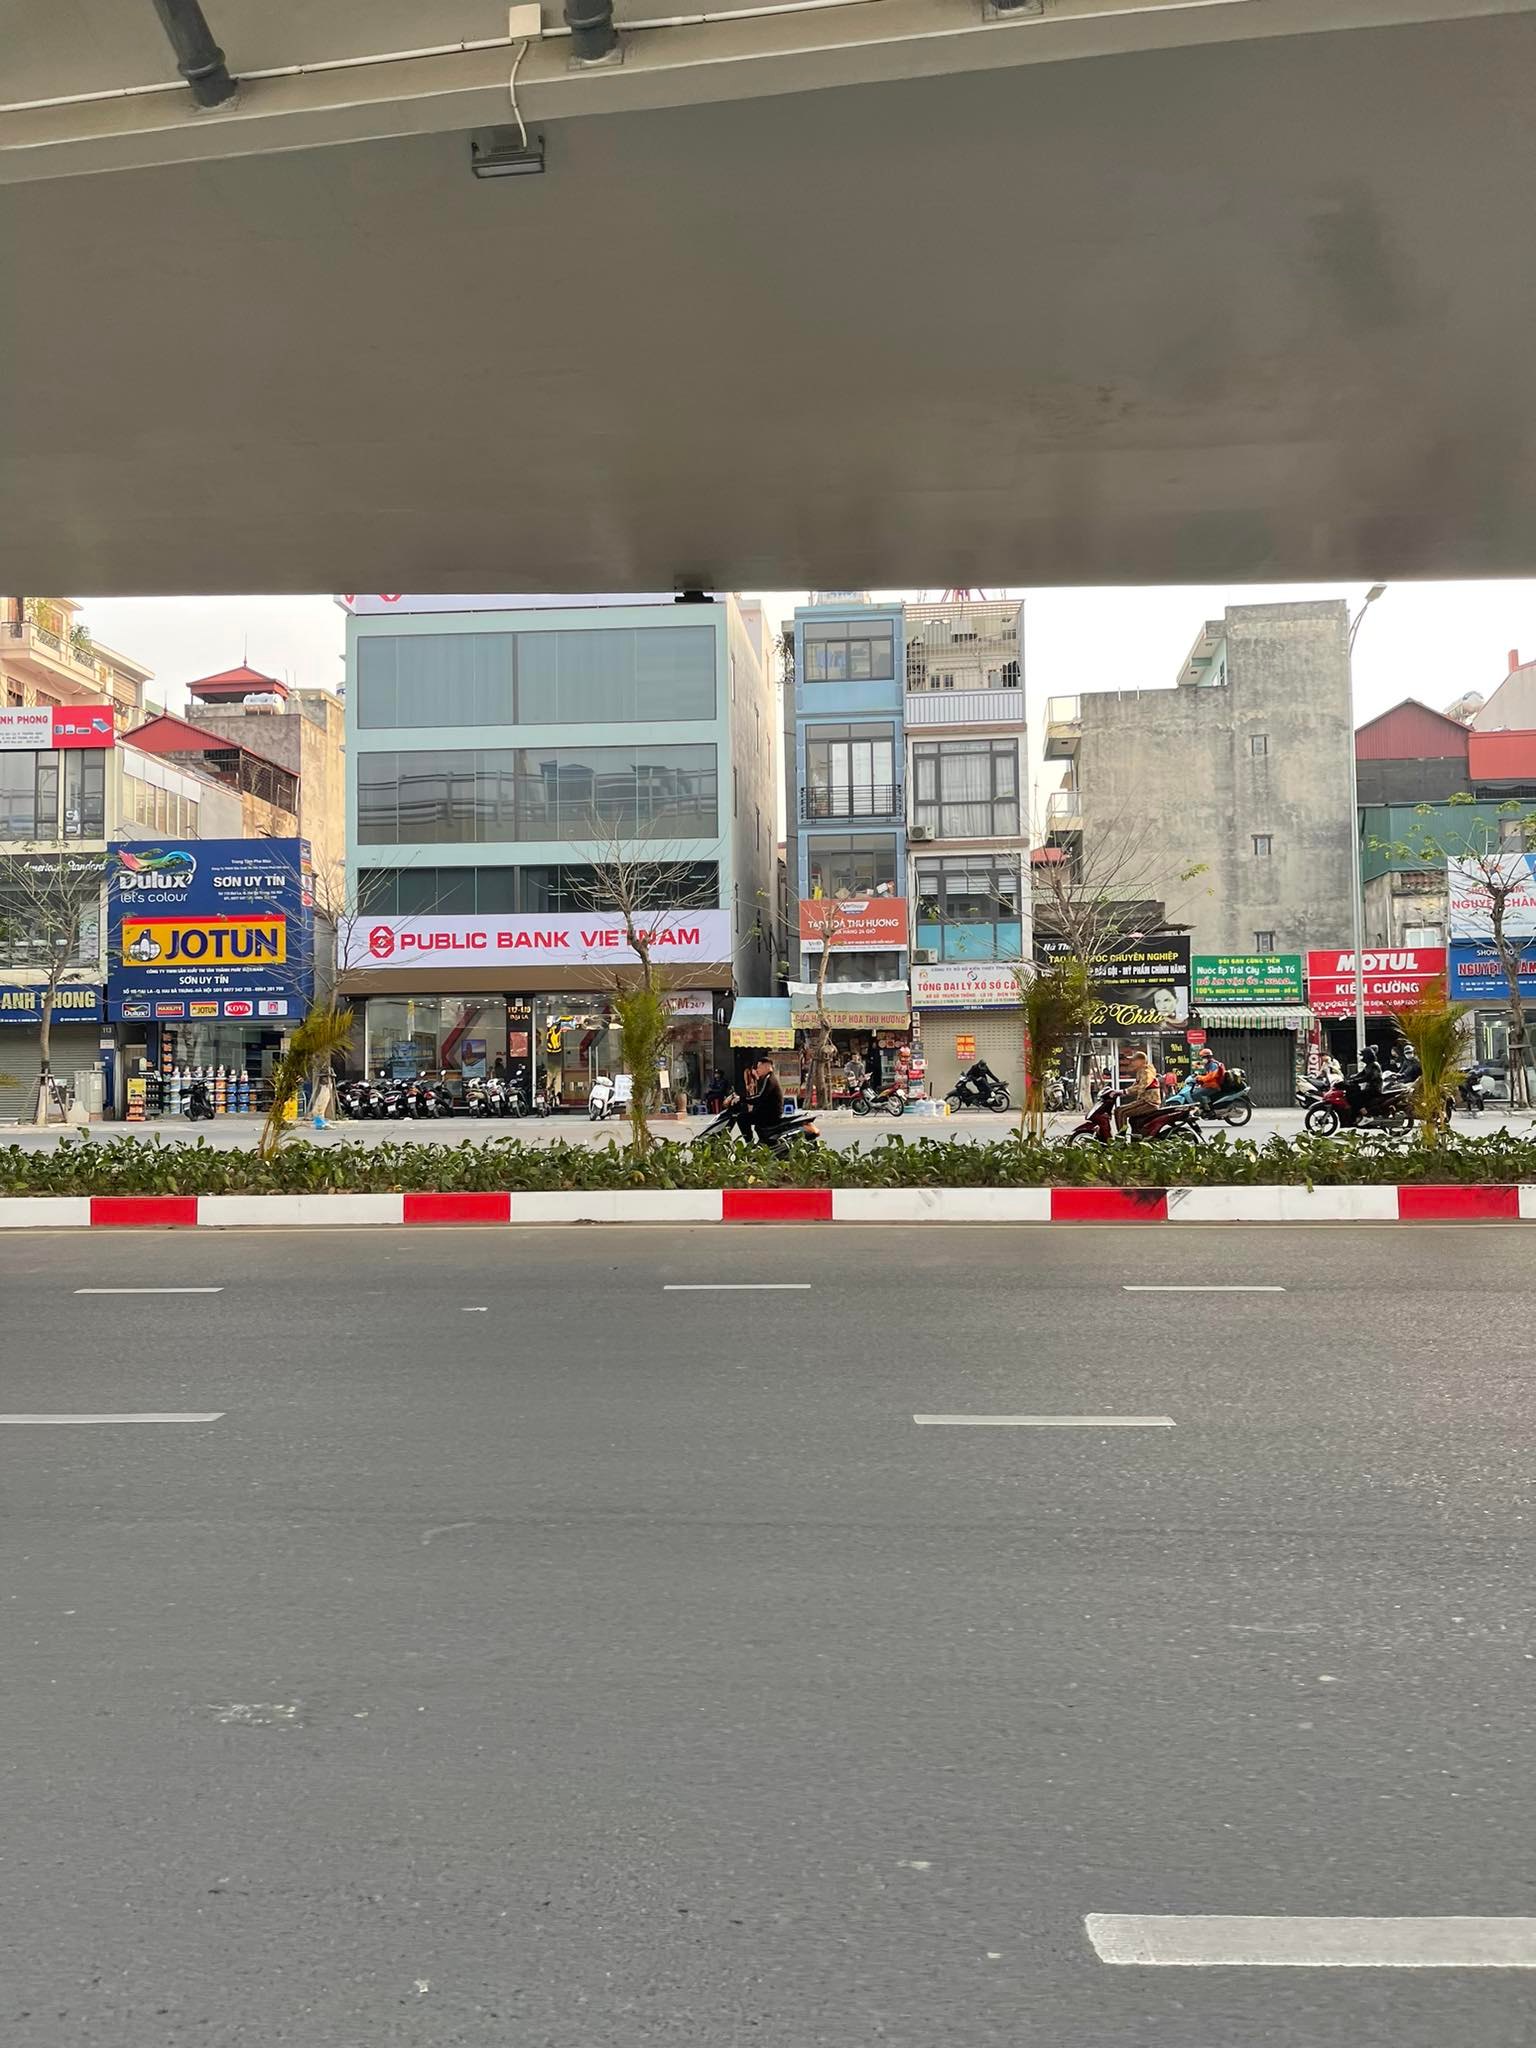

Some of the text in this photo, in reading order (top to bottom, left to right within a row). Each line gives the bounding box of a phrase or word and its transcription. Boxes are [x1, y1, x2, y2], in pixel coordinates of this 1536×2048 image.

[17, 715, 48, 724] PHONG
[119, 871, 187, 889] Dulux
[213, 873, 286, 887] SƠN UY TÍN
[120, 891, 188, 903] let's colour
[847, 919, 864, 928] THU
[866, 918, 899, 928] HƯƠNG
[165, 928, 278, 960] JOTUN
[400, 932, 487, 950] PUBLIC
[497, 931, 570, 948] BANK
[1109, 951, 1145, 962] CHUYÊN
[1146, 950, 1179, 962] NGHIỆP
[1336, 952, 1418, 972] MOTUL
[179, 974, 229, 985] SƠN UY TÍN
[1373, 980, 1420, 993] CƯỜNG
[1, 992, 35, 1009] ANH
